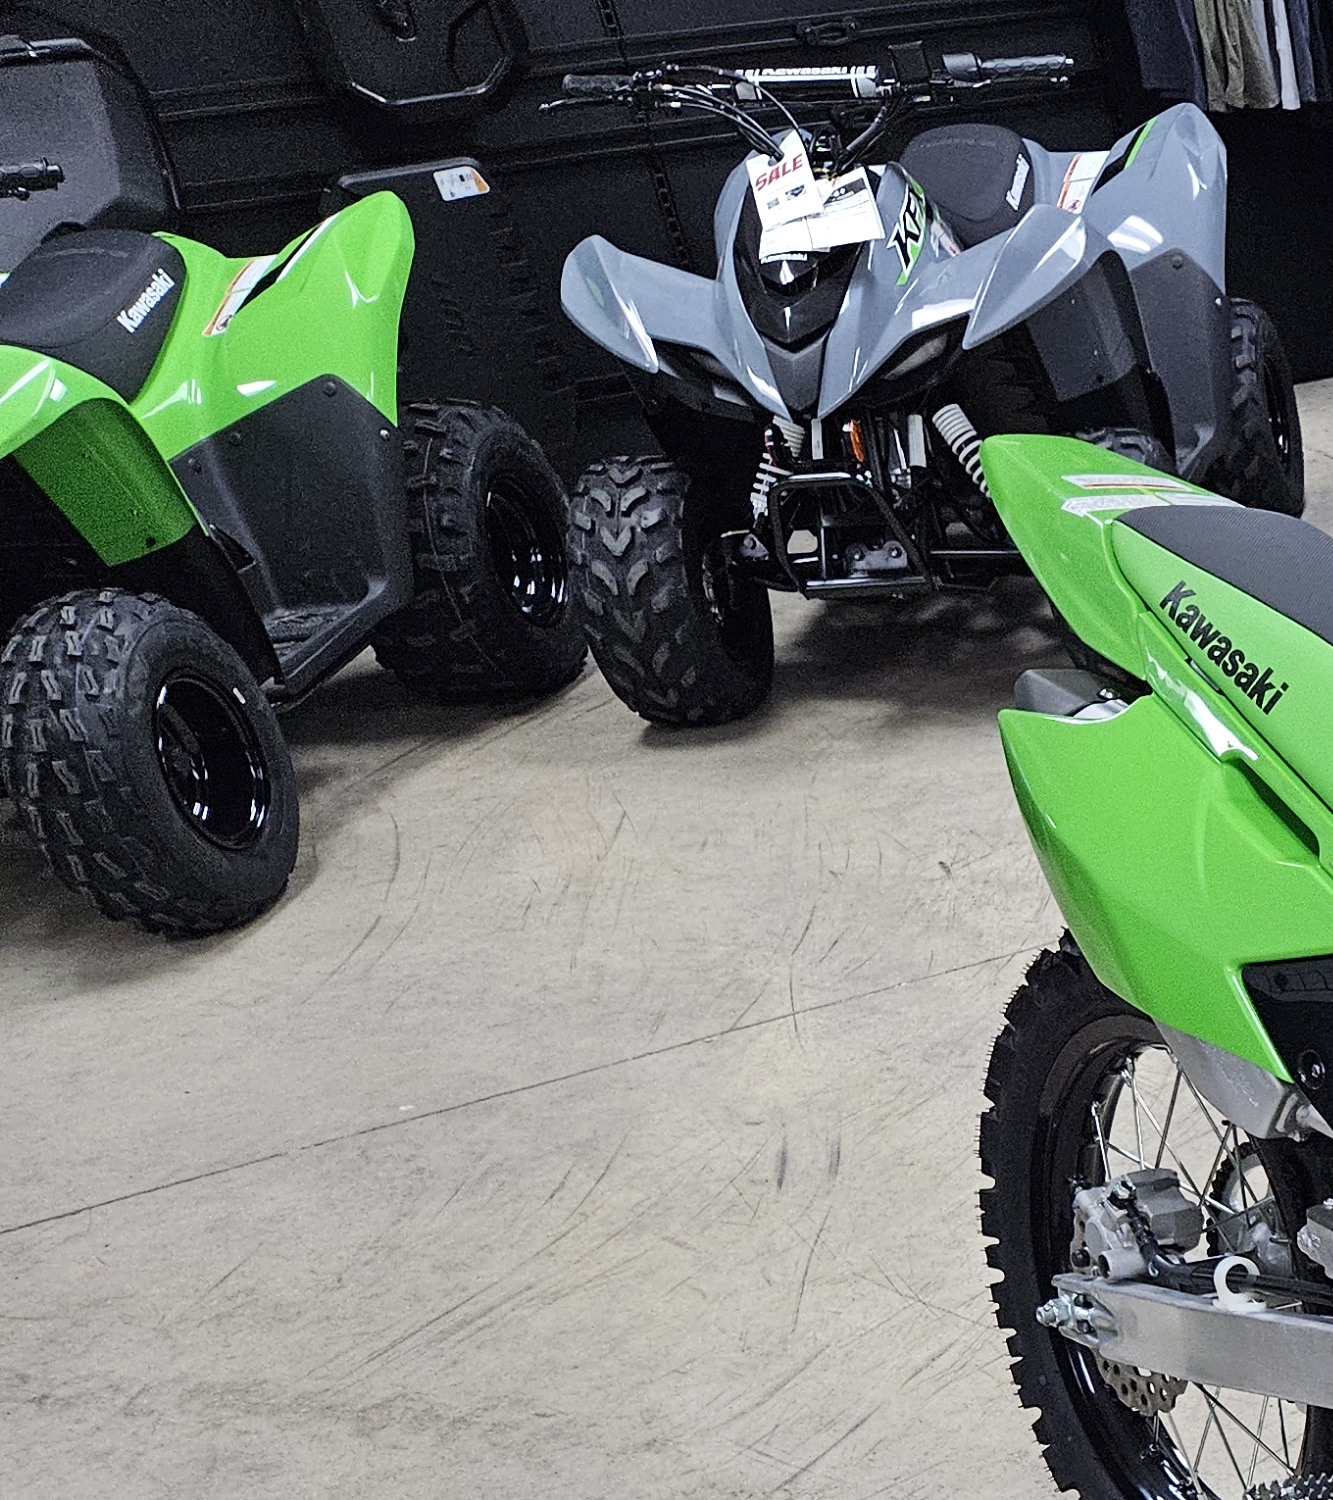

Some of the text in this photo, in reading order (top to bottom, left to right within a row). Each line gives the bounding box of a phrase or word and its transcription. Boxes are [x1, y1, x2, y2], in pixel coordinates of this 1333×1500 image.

[755, 153, 803, 192] SALE
[116, 267, 176, 334] Kawasaki
[1159, 580, 1290, 716] Kawasaki
